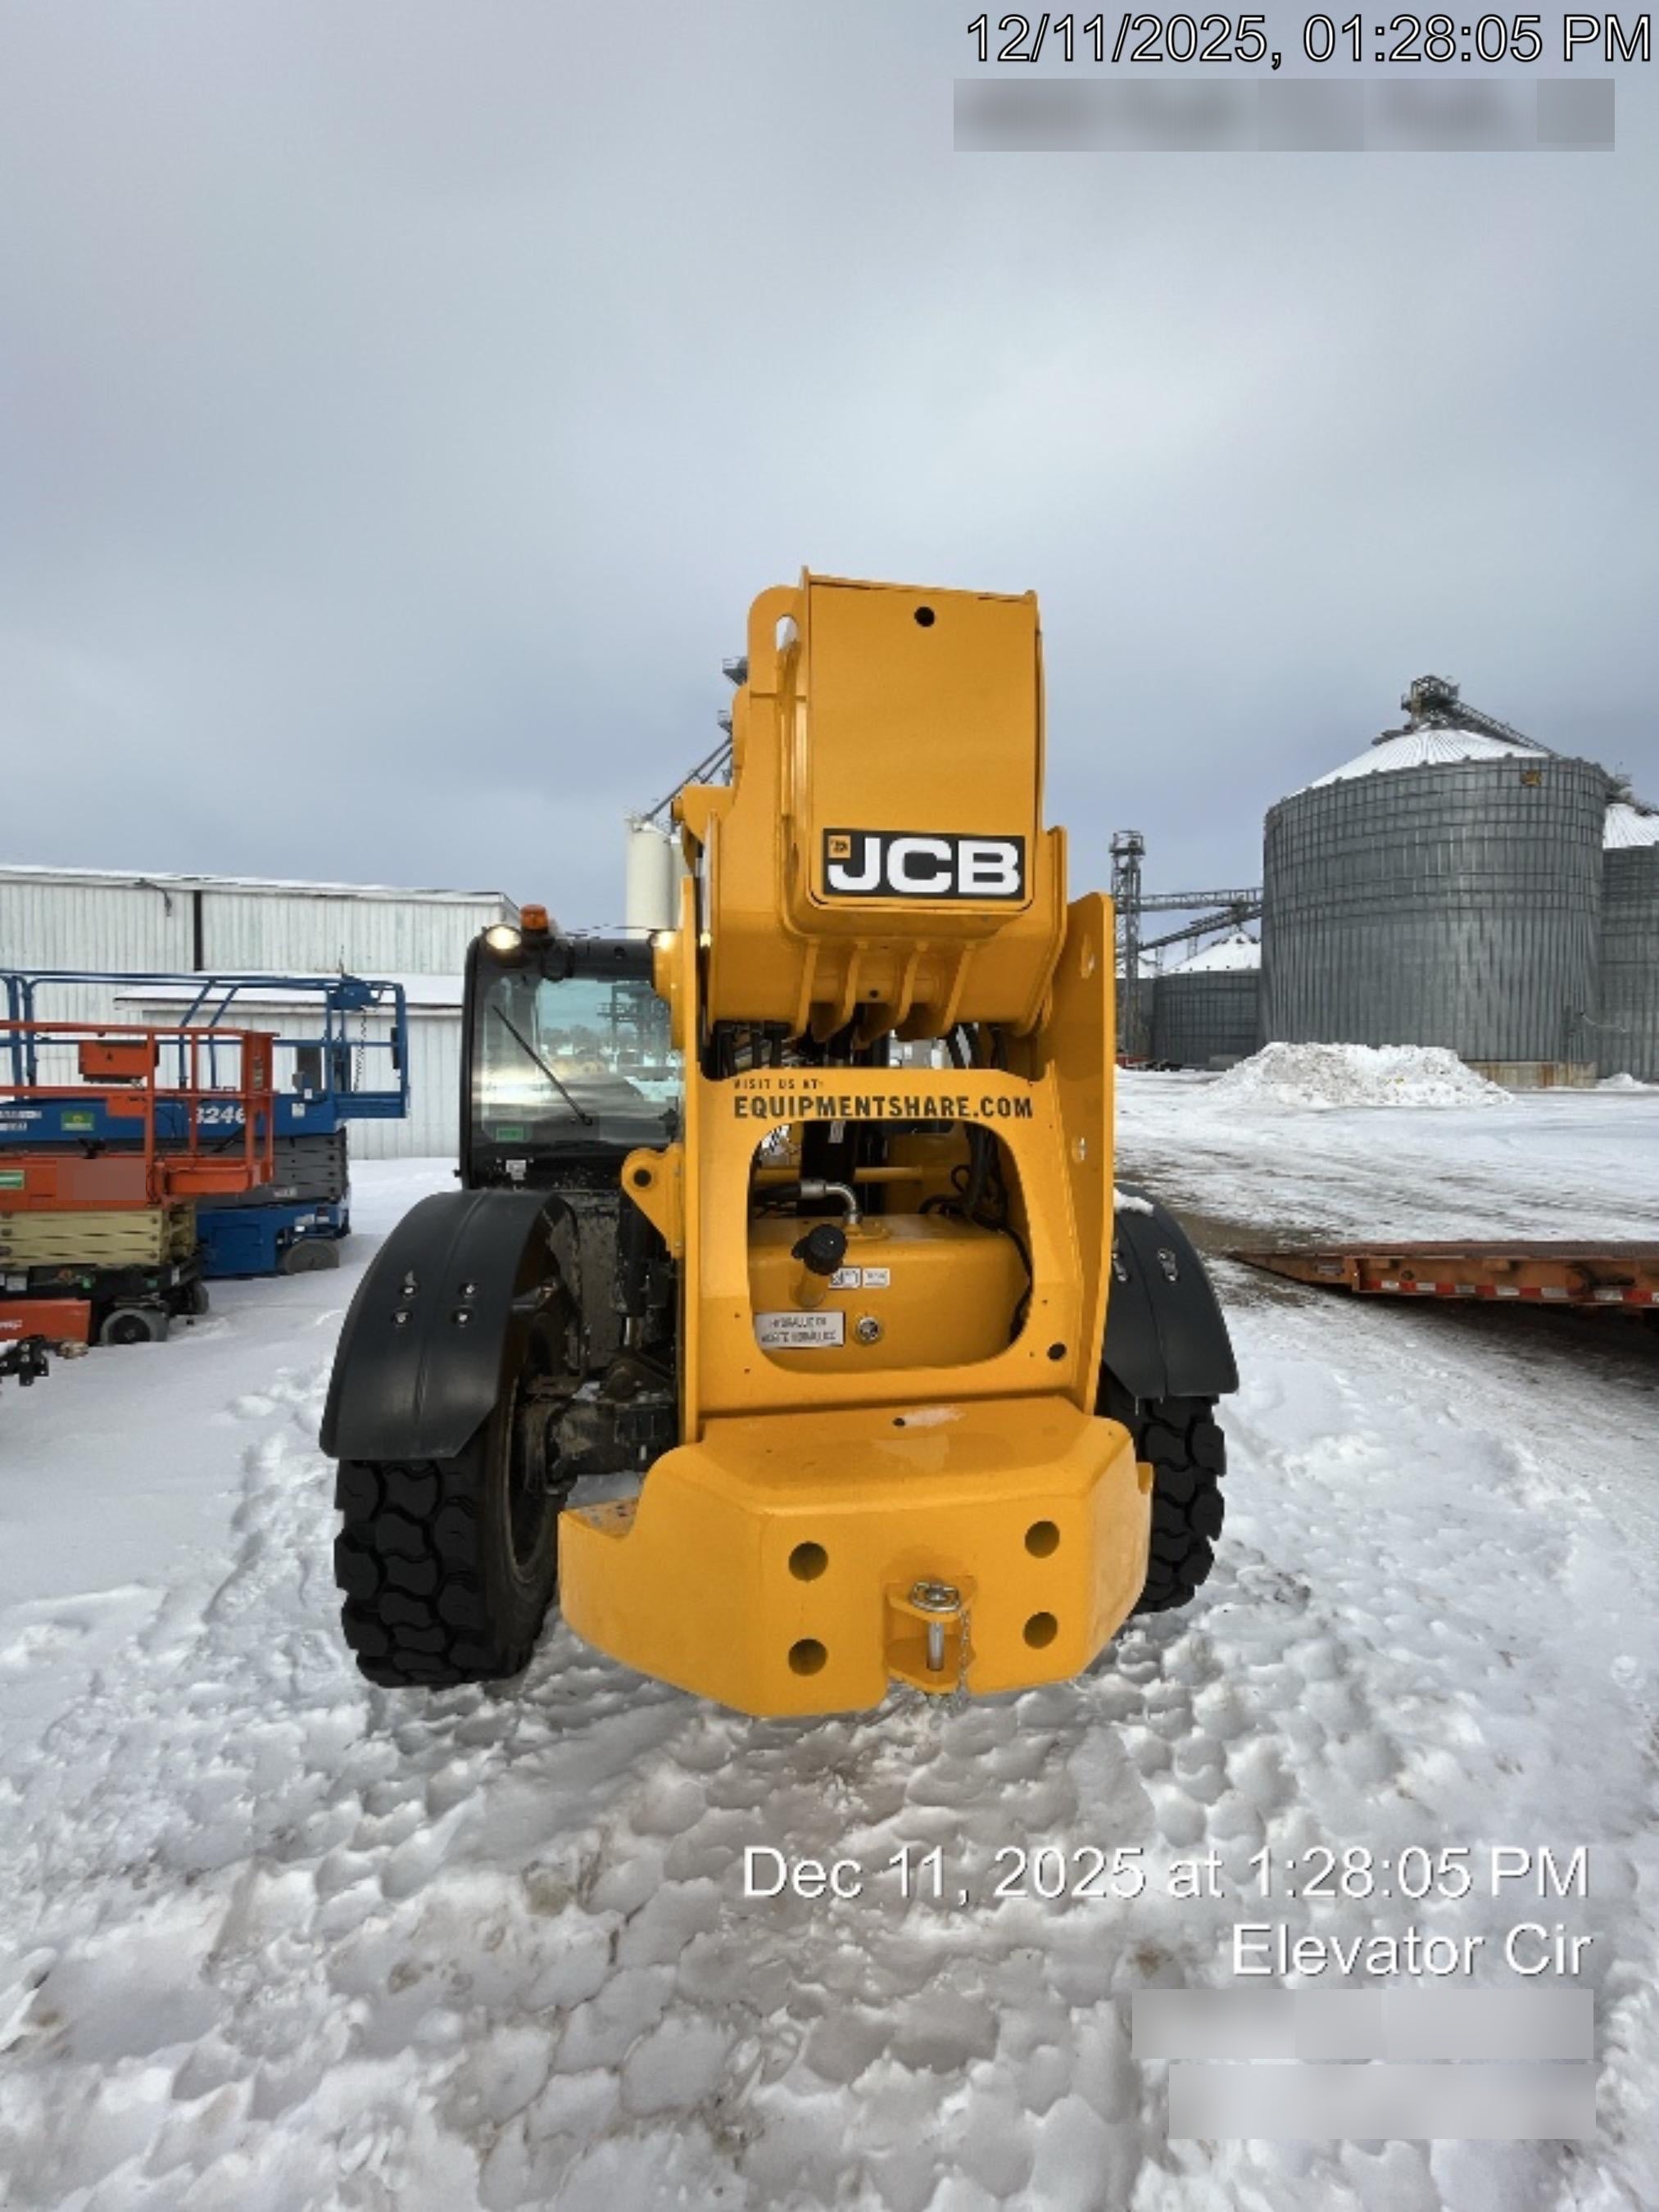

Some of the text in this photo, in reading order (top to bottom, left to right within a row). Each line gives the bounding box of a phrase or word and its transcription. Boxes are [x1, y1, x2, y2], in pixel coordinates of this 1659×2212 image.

[827, 836, 1021, 895] JCB
[734, 1078, 770, 1090] VISIT
[779, 1078, 795, 1090] US
[734, 1095, 1034, 1119] EQUIPMENTSHARE.COM
